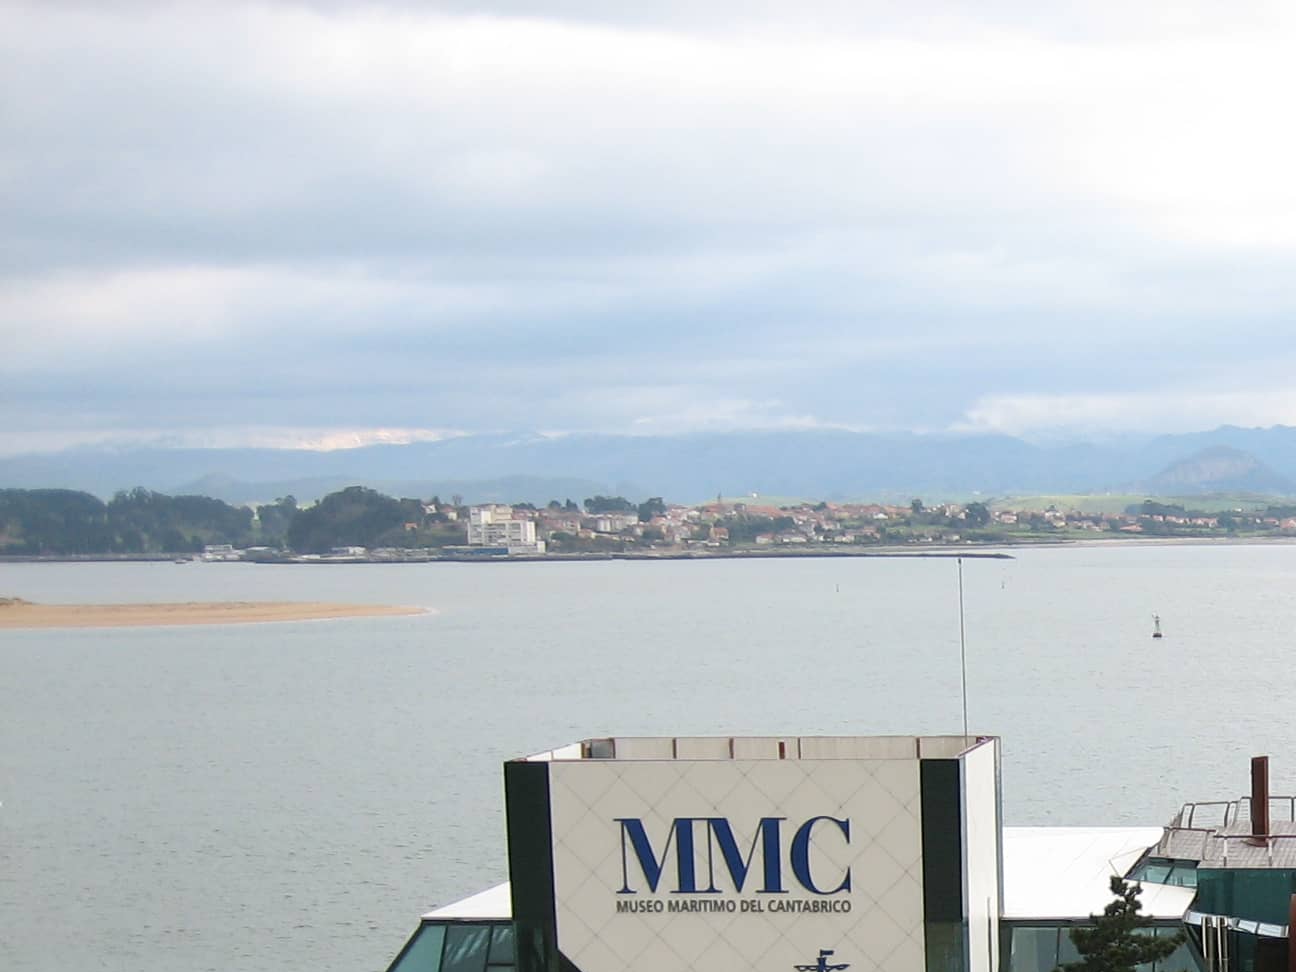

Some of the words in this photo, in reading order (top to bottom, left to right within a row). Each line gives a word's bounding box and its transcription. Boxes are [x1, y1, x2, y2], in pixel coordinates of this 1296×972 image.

[613, 815, 852, 895] MMC
[616, 900, 664, 913] MUSEO
[667, 900, 736, 913] MARITIMO
[740, 900, 764, 913] DEL
[767, 900, 852, 913] CANTABRICO
